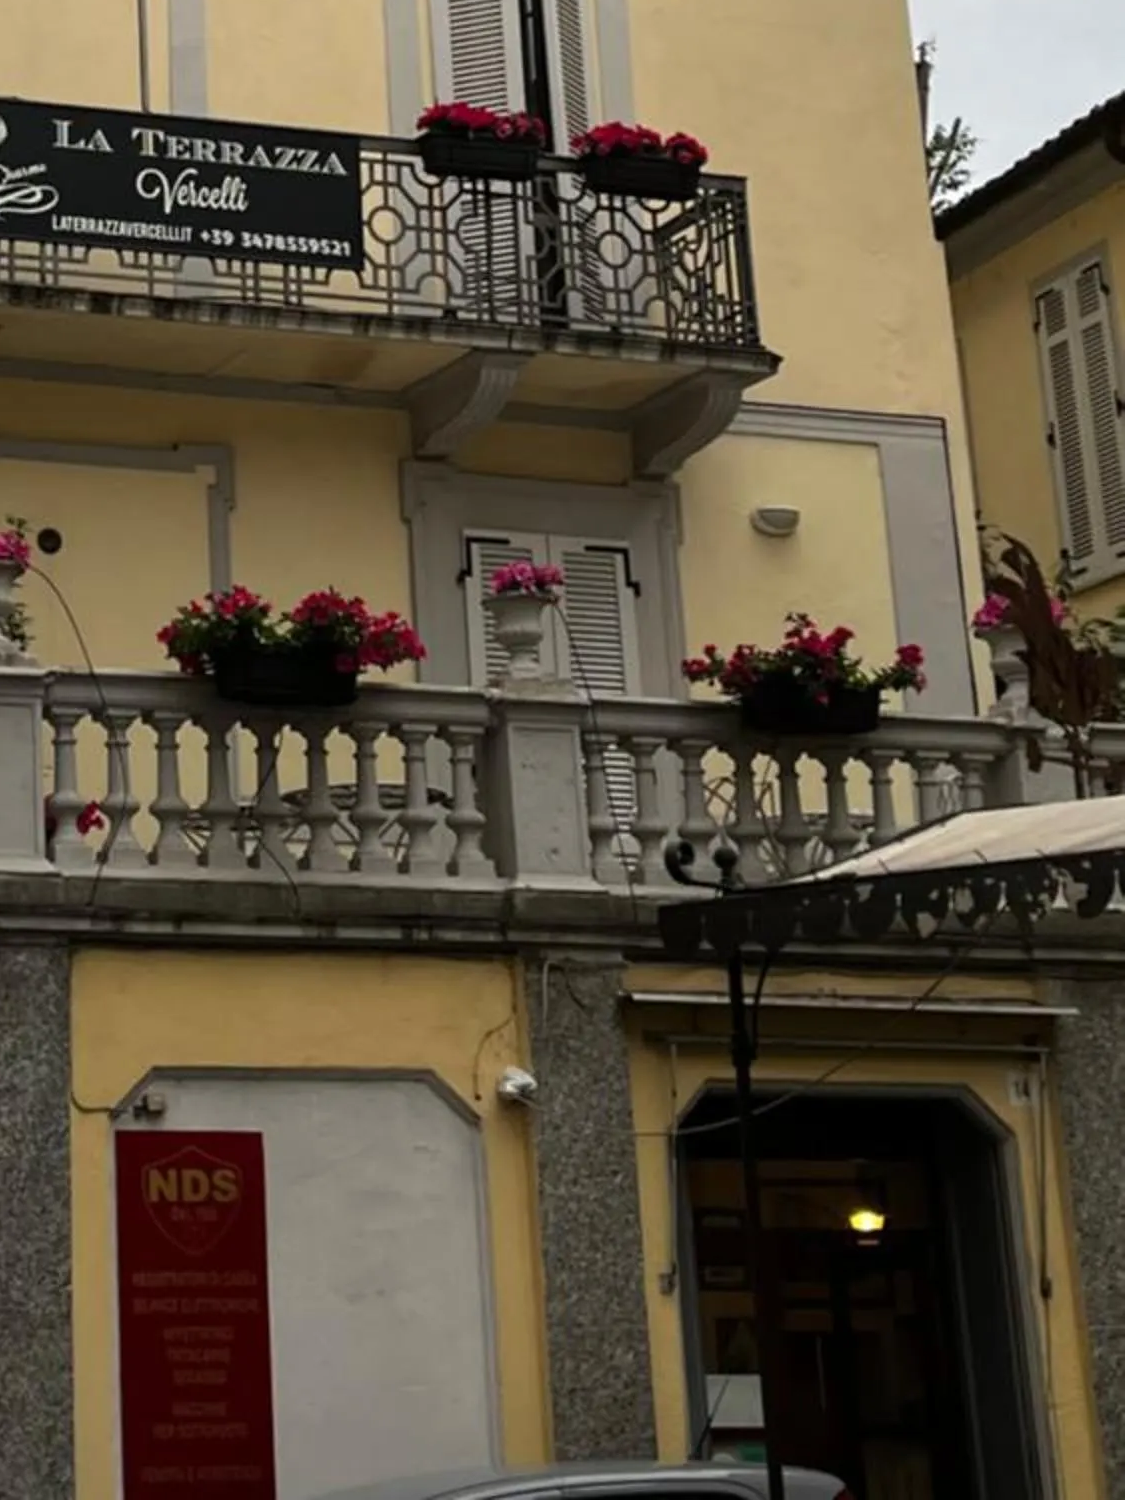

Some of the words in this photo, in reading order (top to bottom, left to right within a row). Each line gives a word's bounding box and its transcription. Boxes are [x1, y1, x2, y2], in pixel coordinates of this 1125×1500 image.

[52, 119, 114, 153] LA
[131, 127, 349, 176] TERRAZZA
[136, 167, 250, 214] Vercelli
[200, 228, 235, 247] +39
[148, 1167, 238, 1203] NDS
